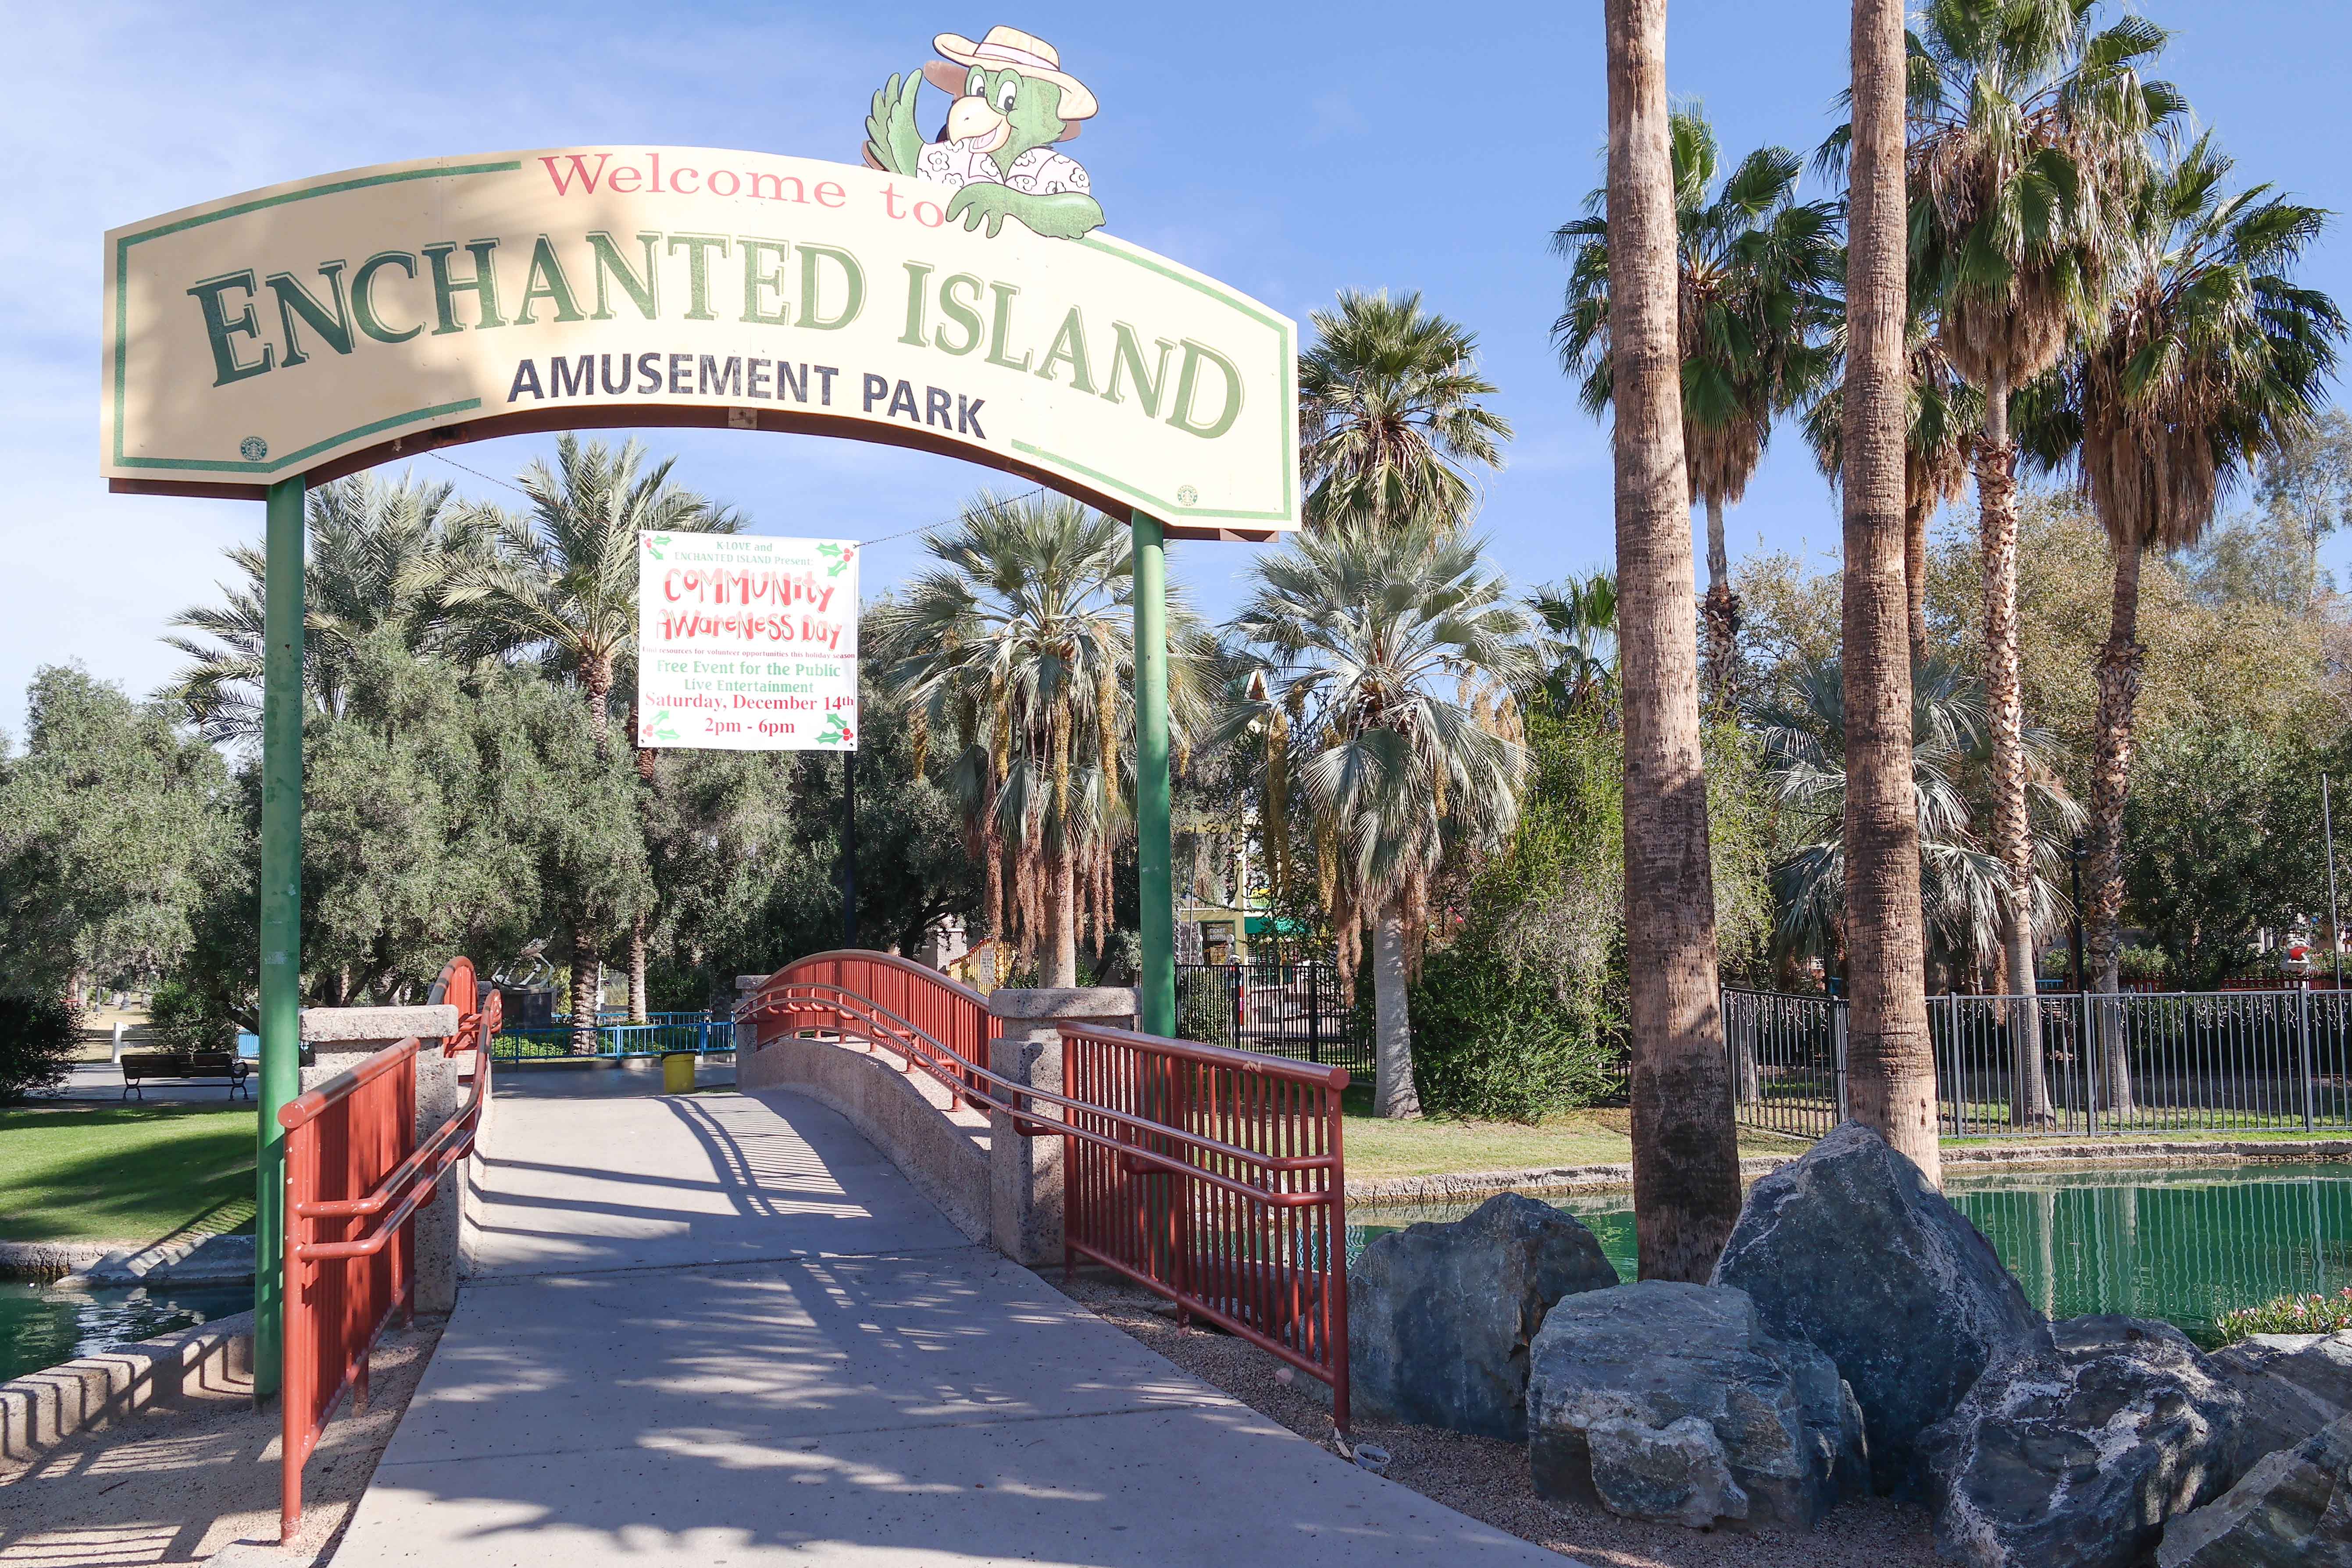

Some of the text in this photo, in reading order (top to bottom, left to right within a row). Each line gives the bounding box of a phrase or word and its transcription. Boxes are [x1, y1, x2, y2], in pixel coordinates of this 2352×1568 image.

[538, 153, 944, 228] Welcome to
[186, 230, 1244, 439] ENCHANTED ISLAND
[507, 352, 986, 440] AMUSEMENT PARK
[717, 542, 772, 552] K-LOVE and
[675, 552, 733, 563] ENCHANTED
[737, 554, 771, 564] ISLAND
[657, 660, 841, 677] Free Event for the Public
[685, 678, 814, 693] Live Entertainment
[645, 691, 854, 712] Saturday, December 14th
[705, 717, 741, 736] 2pm
[759, 719, 795, 737] 6pm
